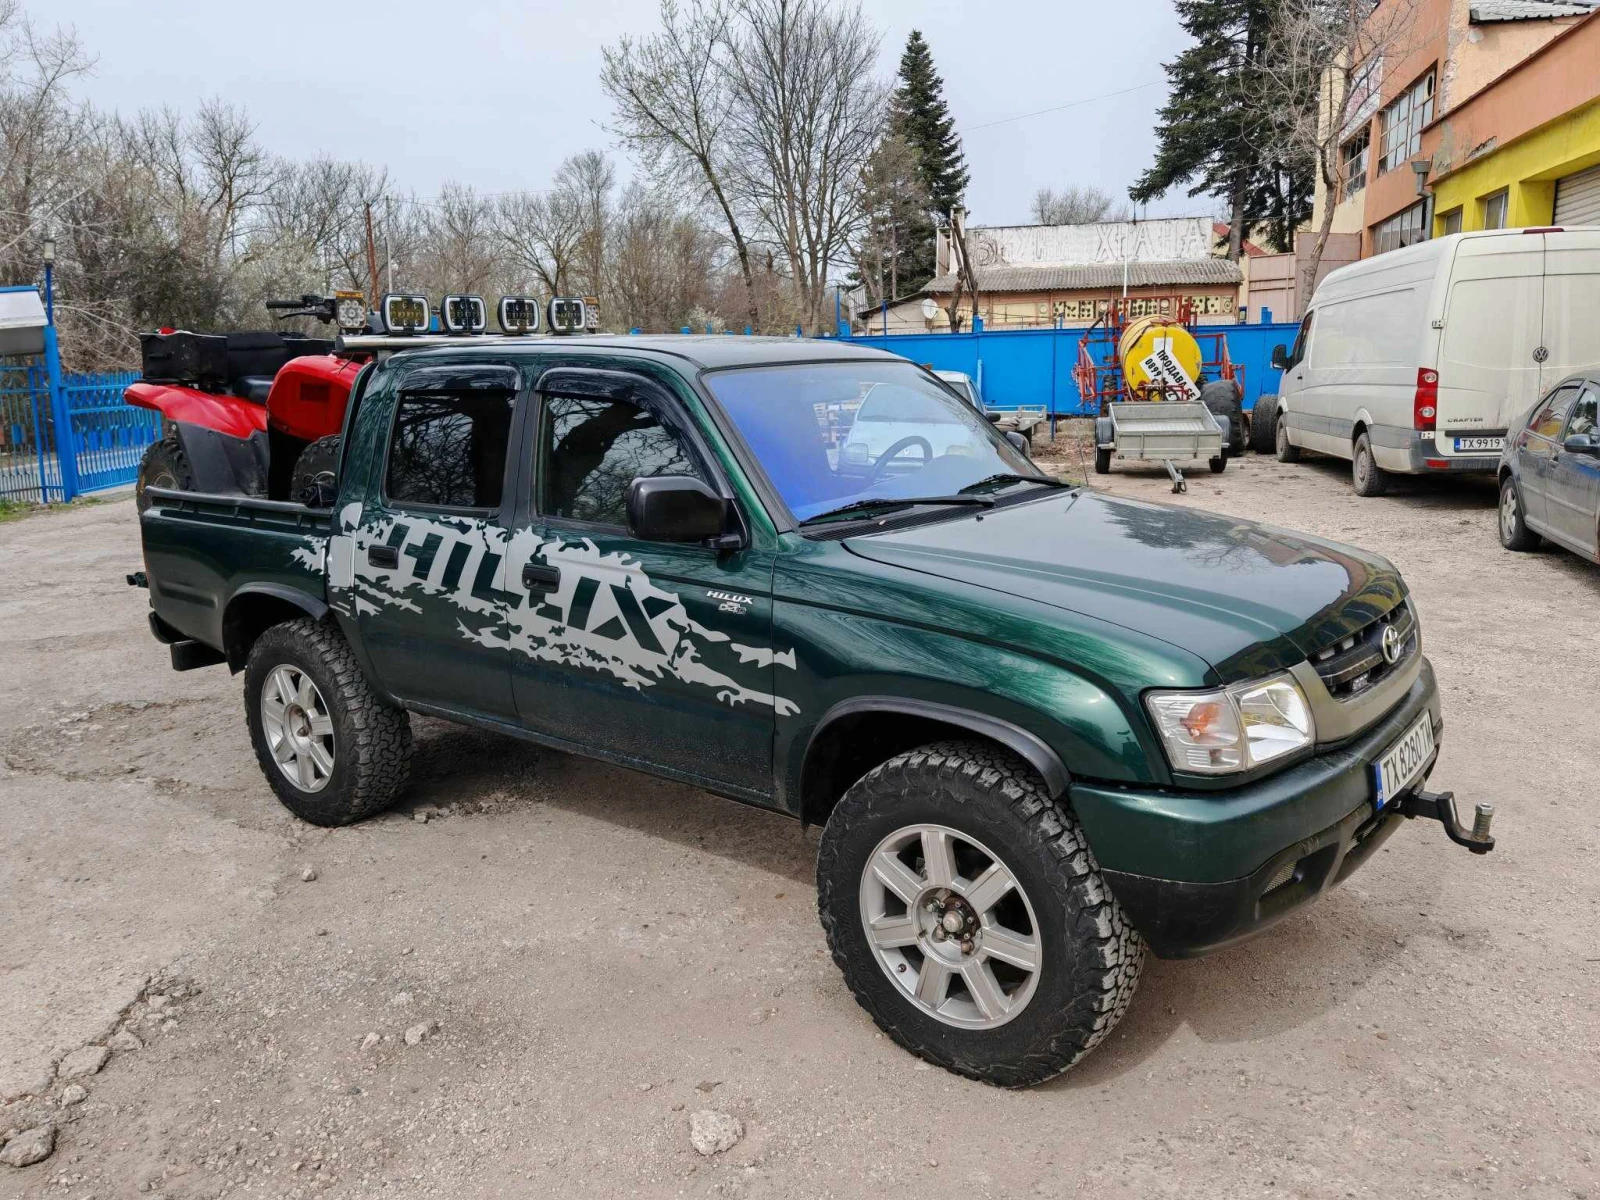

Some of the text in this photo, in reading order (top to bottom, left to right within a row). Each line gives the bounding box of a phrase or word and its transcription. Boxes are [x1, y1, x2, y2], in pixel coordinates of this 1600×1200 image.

[1145, 358, 1162, 377] 0899
[1462, 439, 1475, 448] TX
[1476, 438, 1501, 448] 9919
[706, 590, 753, 605] HILUX
[1383, 752, 1401, 795] TX
